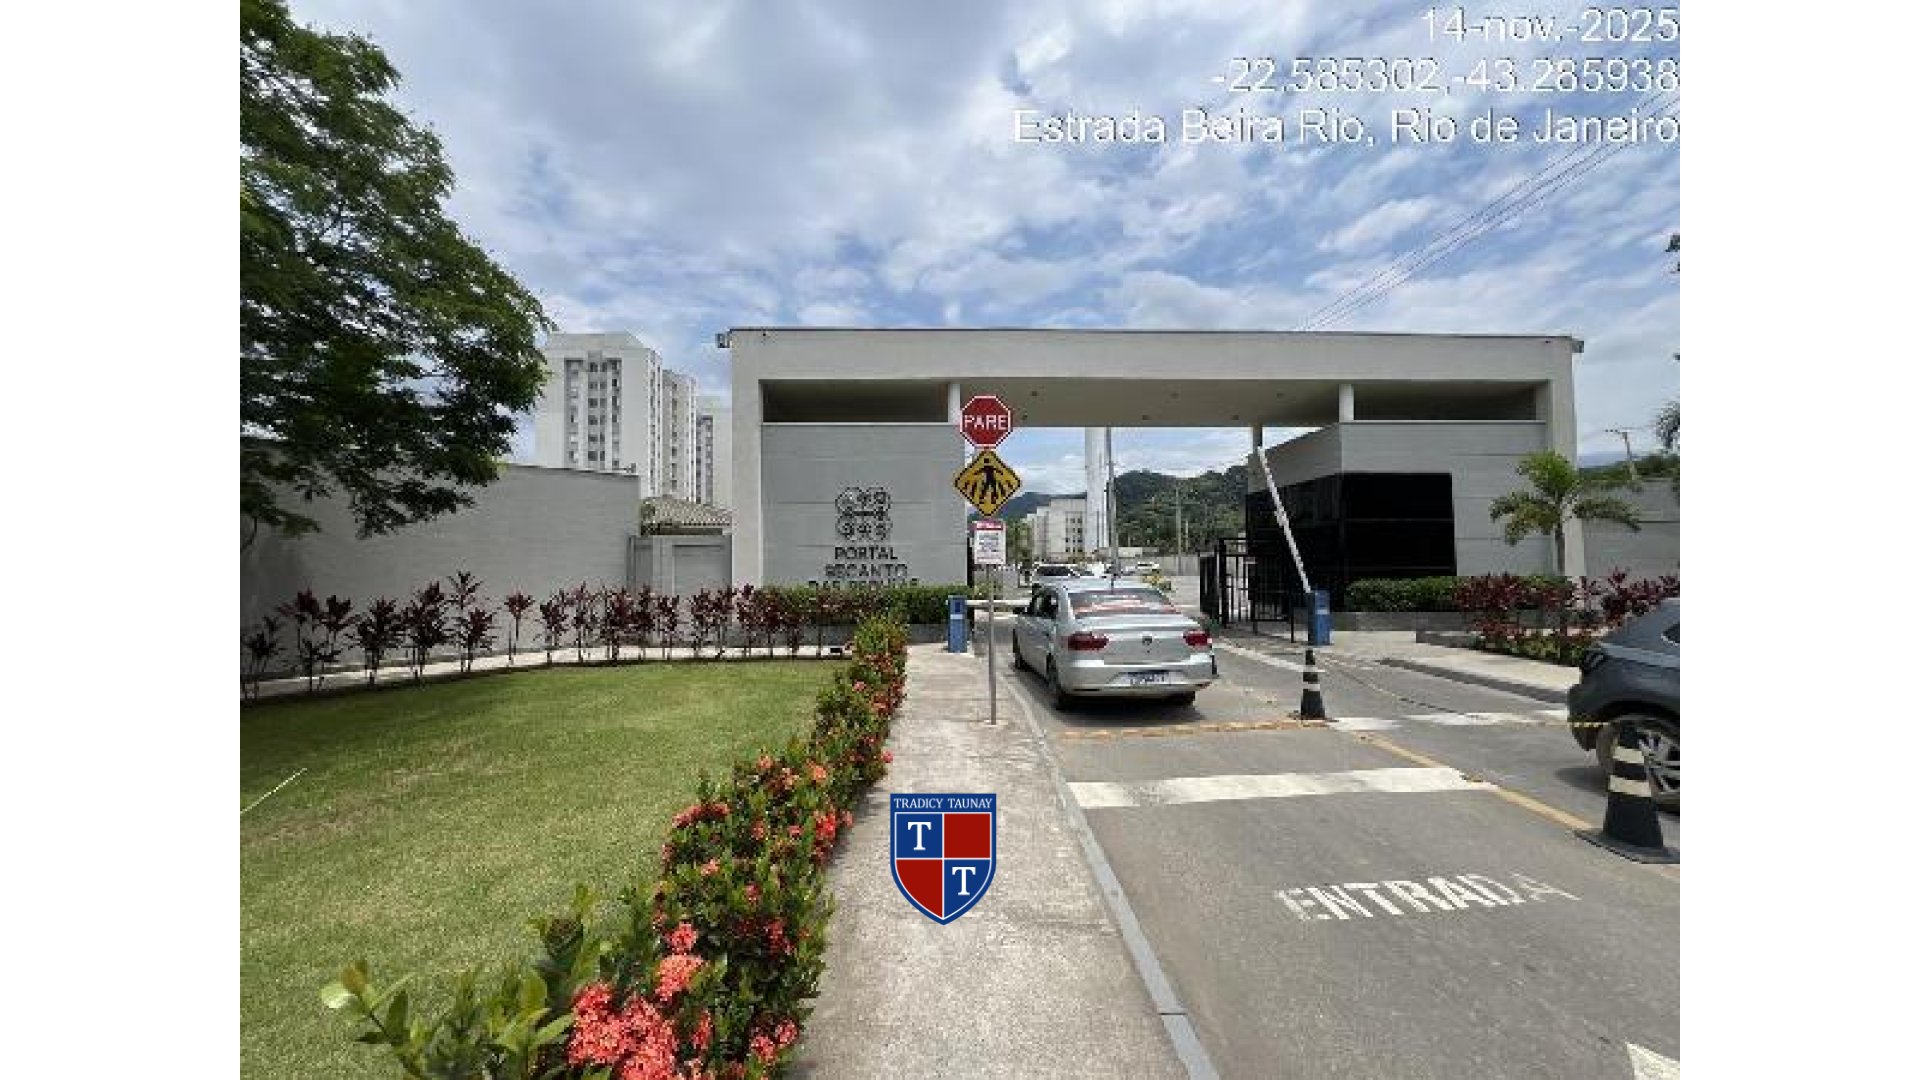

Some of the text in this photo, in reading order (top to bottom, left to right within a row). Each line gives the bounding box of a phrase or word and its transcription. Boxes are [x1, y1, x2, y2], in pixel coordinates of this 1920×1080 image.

[964, 414, 1007, 430] PARE
[834, 546, 898, 560] PORTAL
[1273, 872, 1582, 920] ENTRADA
